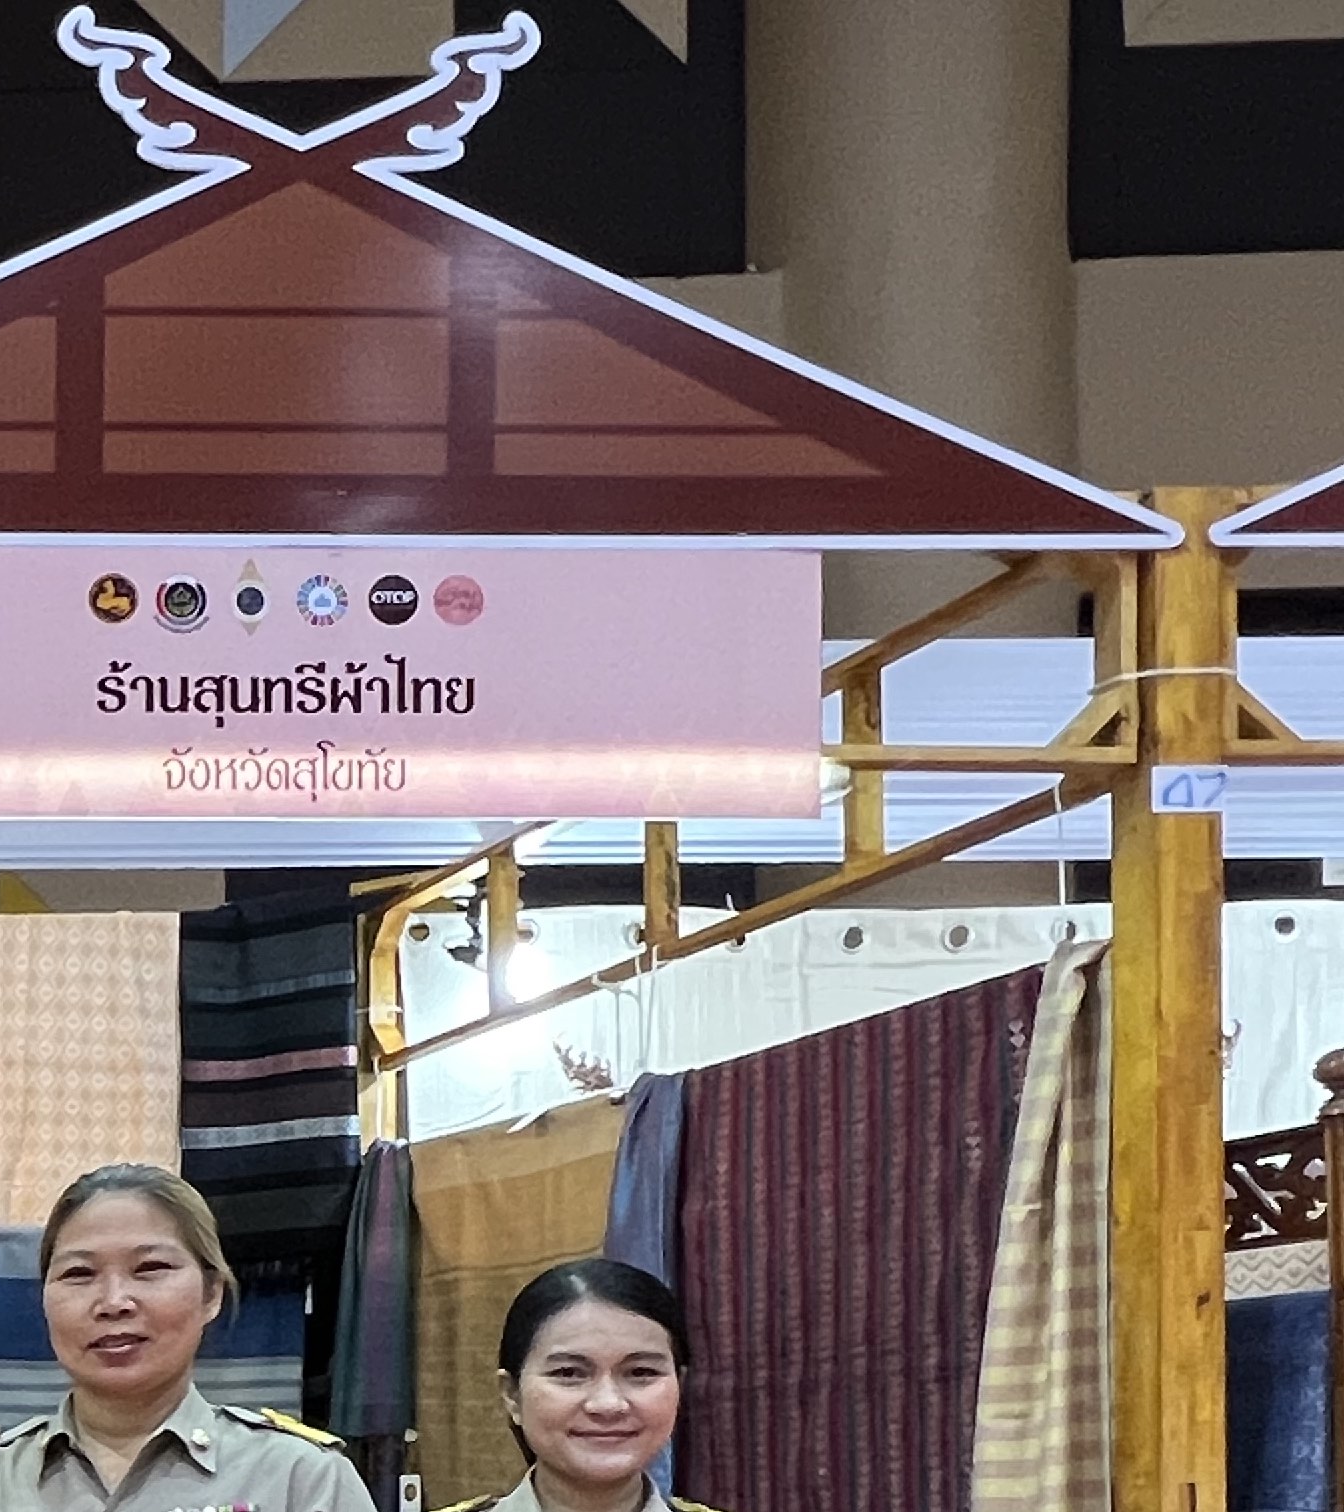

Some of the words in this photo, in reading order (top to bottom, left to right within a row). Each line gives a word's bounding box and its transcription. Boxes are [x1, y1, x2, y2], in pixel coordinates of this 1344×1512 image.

[96, 653, 476, 729] ร้านสุนทรีผ้าไทย
[162, 740, 407, 803] จังหวัดสุโขทัย
[1162, 771, 1228, 808] 47
